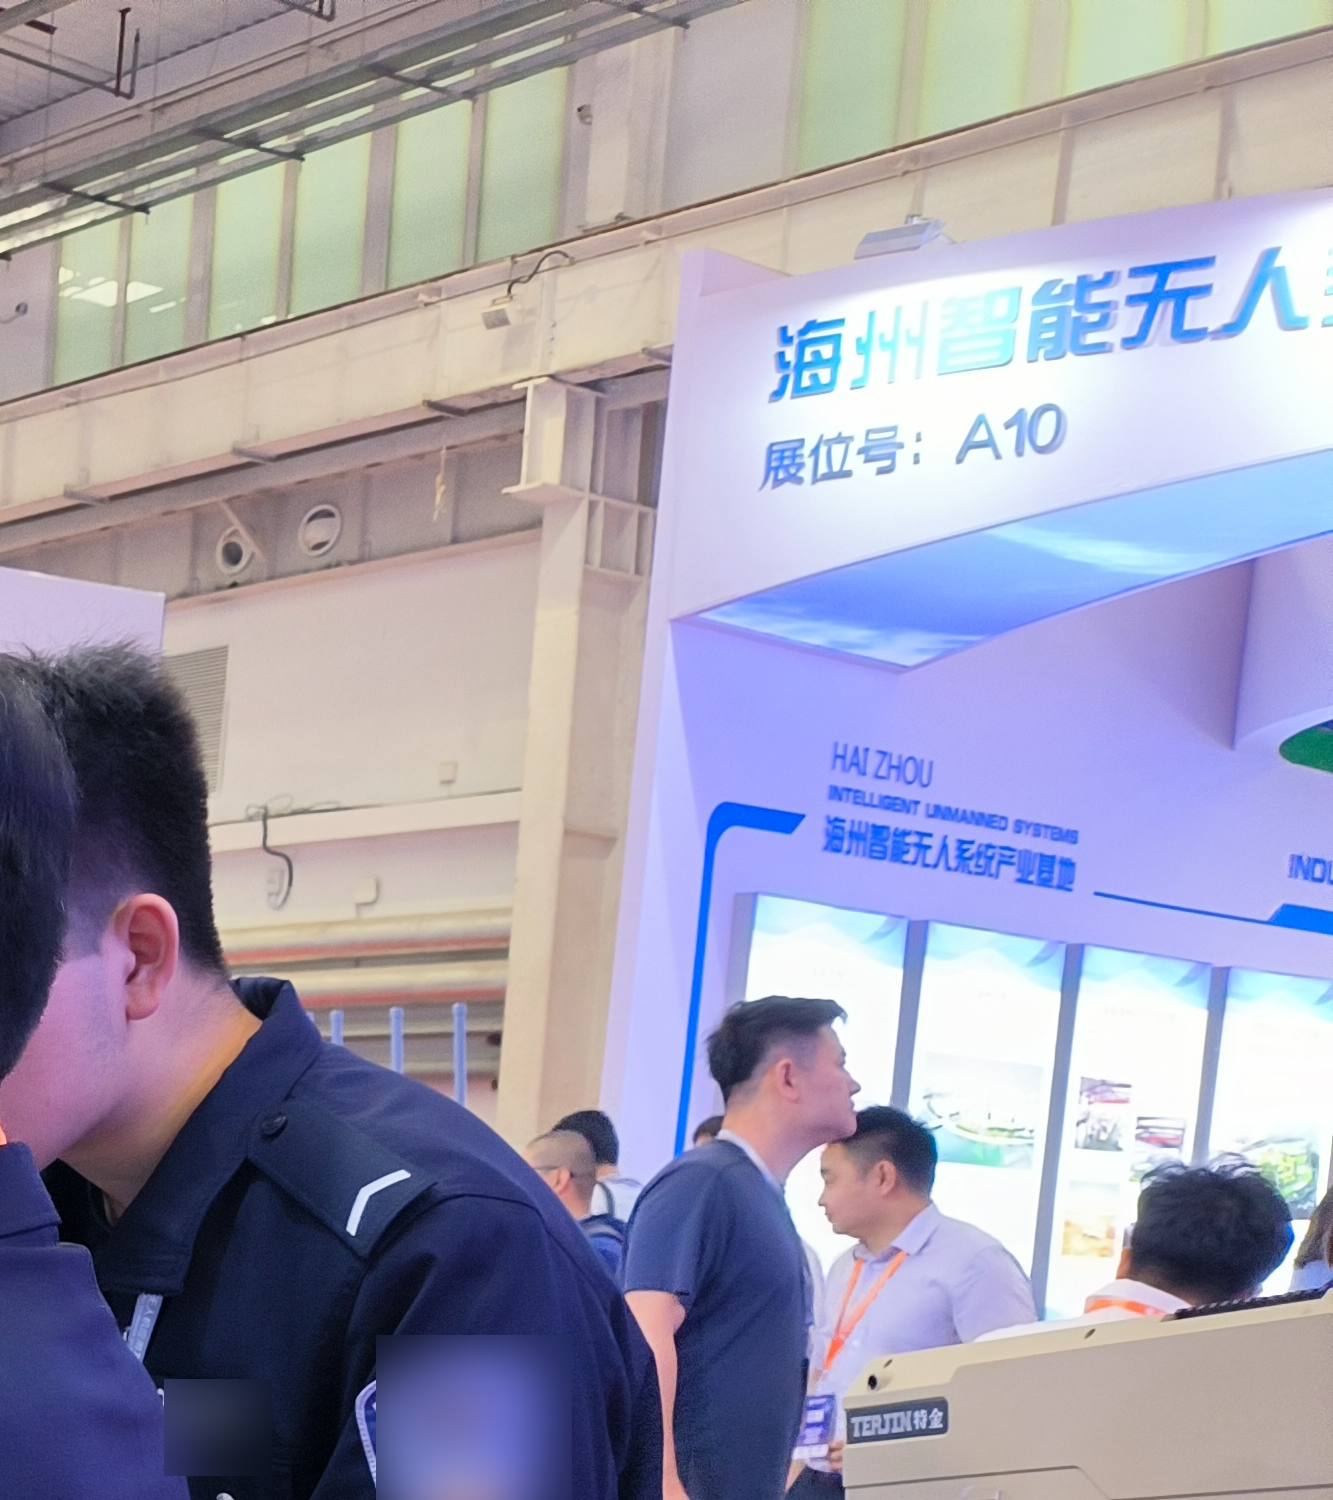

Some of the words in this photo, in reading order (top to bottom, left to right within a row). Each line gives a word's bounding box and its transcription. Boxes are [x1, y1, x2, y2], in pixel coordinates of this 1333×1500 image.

[768, 246, 1333, 403] 海州智能无人
[955, 403, 1066, 464] A10
[831, 741, 870, 776] HAI
[874, 750, 934, 788] ZHOU
[828, 785, 921, 815] INTELLIGENT
[925, 803, 1009, 832] UNMANNED
[1013, 818, 1080, 845] SYSTEMS
[850, 1410, 913, 1438] TERJIN
[913, 1406, 945, 1431] 特金
